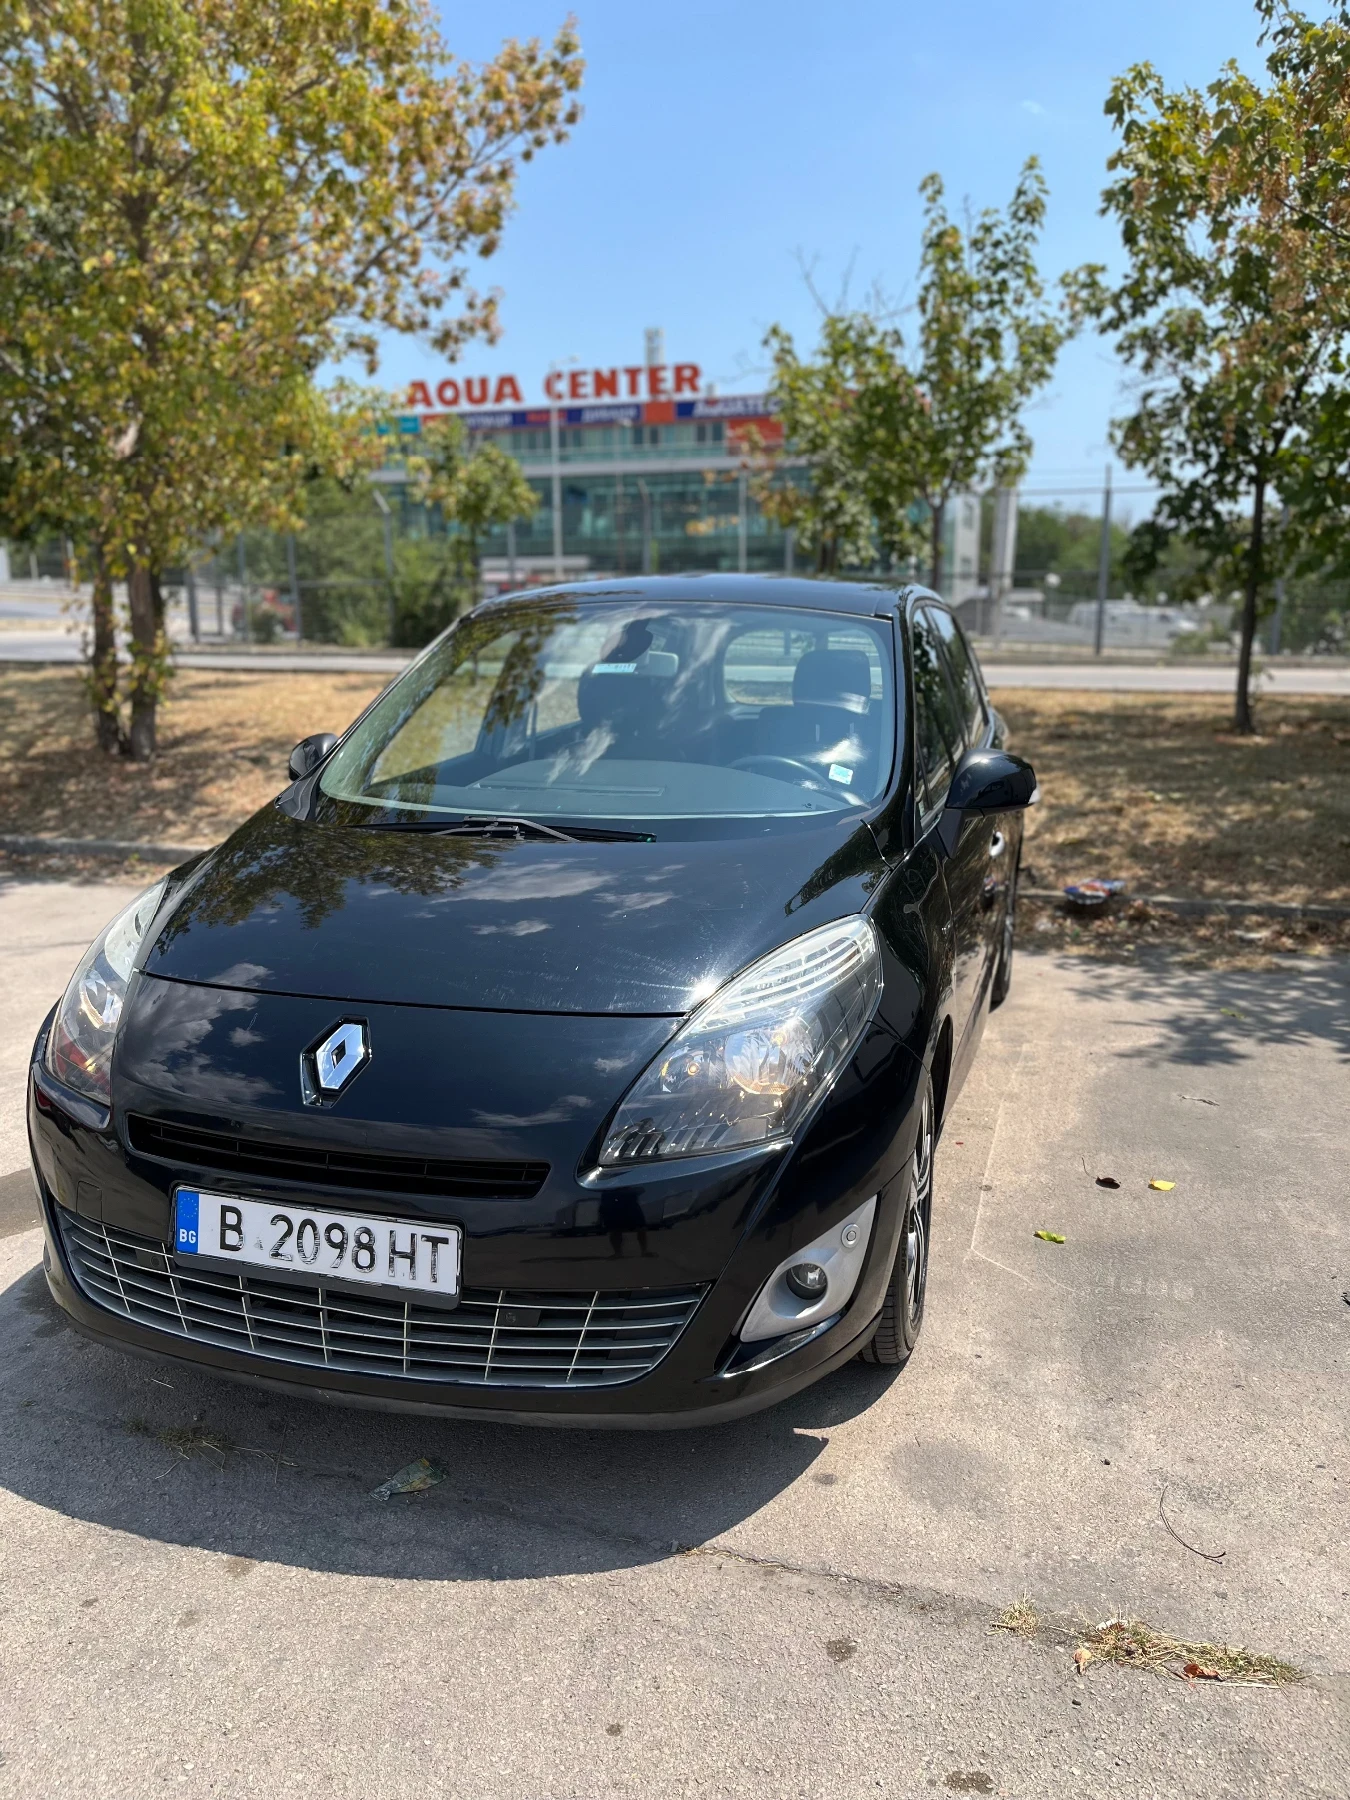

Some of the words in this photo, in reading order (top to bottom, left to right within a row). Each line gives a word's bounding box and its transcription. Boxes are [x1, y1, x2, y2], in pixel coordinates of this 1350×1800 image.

[406, 375, 523, 408] AQUA
[543, 363, 702, 400] CENTER
[179, 1228, 197, 1244] BG
[219, 1204, 245, 1252] B
[269, 1213, 377, 1274] 2098
[387, 1229, 450, 1284] HT
